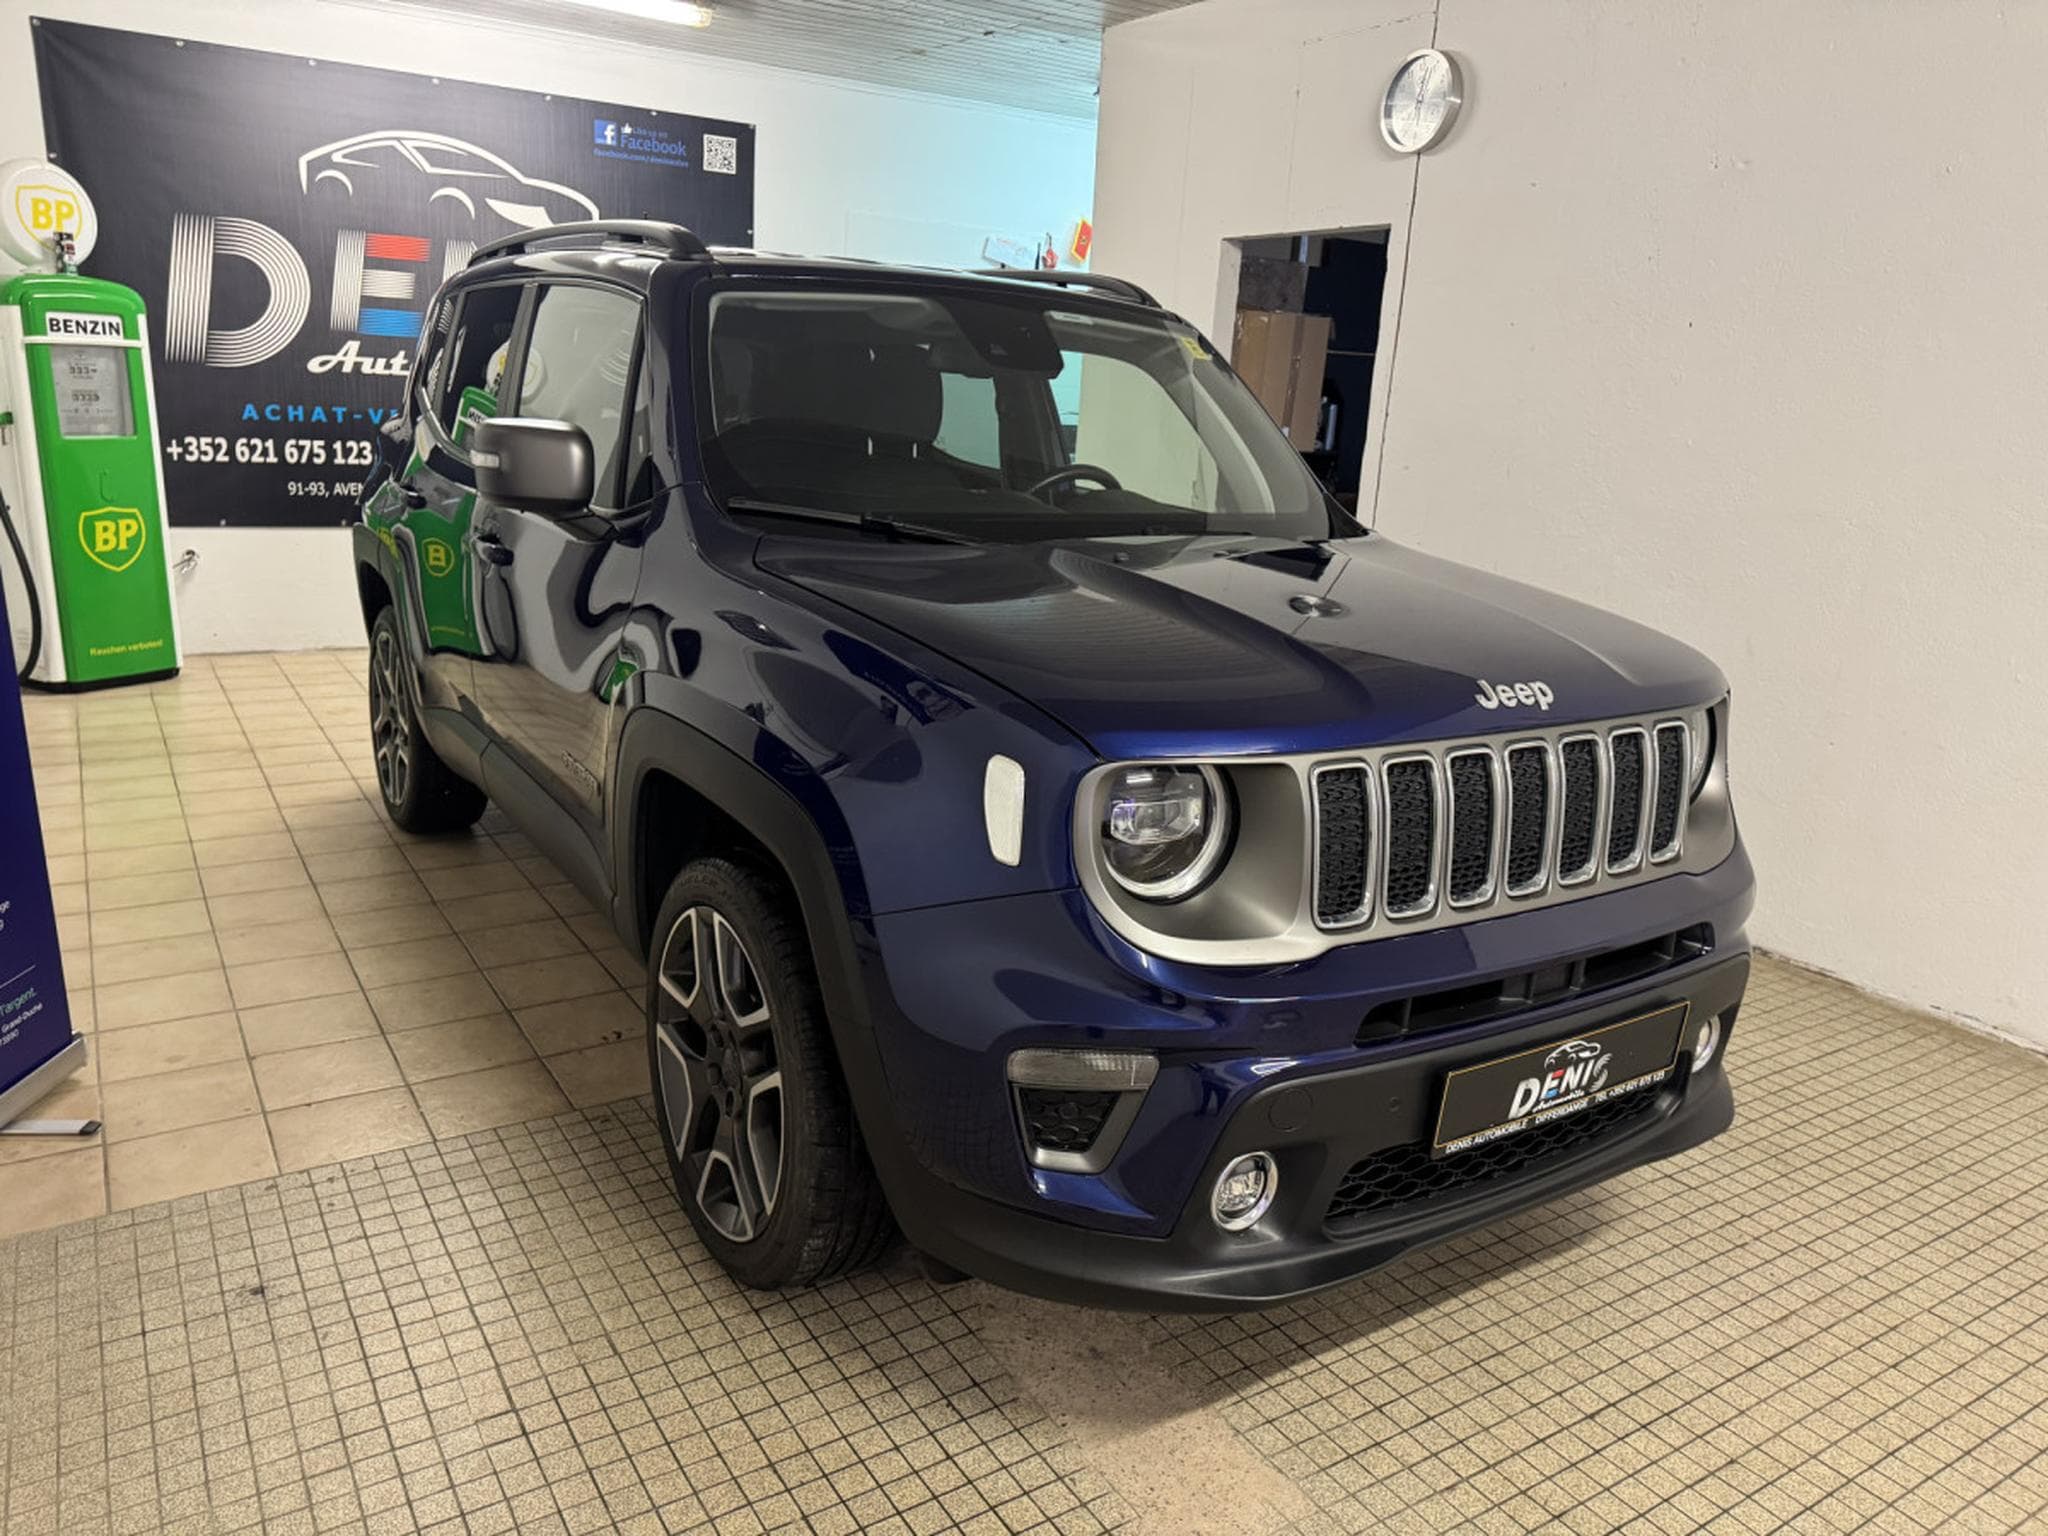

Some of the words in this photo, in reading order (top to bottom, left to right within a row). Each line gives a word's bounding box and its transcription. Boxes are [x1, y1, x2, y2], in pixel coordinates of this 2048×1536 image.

[620, 134, 687, 157] Facebook
[31, 197, 75, 233] BP
[165, 211, 477, 368] DE
[48, 317, 121, 336] BENZIN
[306, 340, 412, 377] Aut
[166, 436, 230, 463] +352
[235, 438, 279, 464] 621
[284, 440, 327, 465] 675
[332, 441, 373, 466] 123
[287, 481, 330, 498] 91-93,
[94, 518, 139, 553] BP
[89, 643, 128, 656] Rauschen
[1474, 679, 1555, 711] Jeep
[1508, 1053, 1613, 1120] DENIS
[1472, 1119, 1529, 1145] AUTOMOBILE
